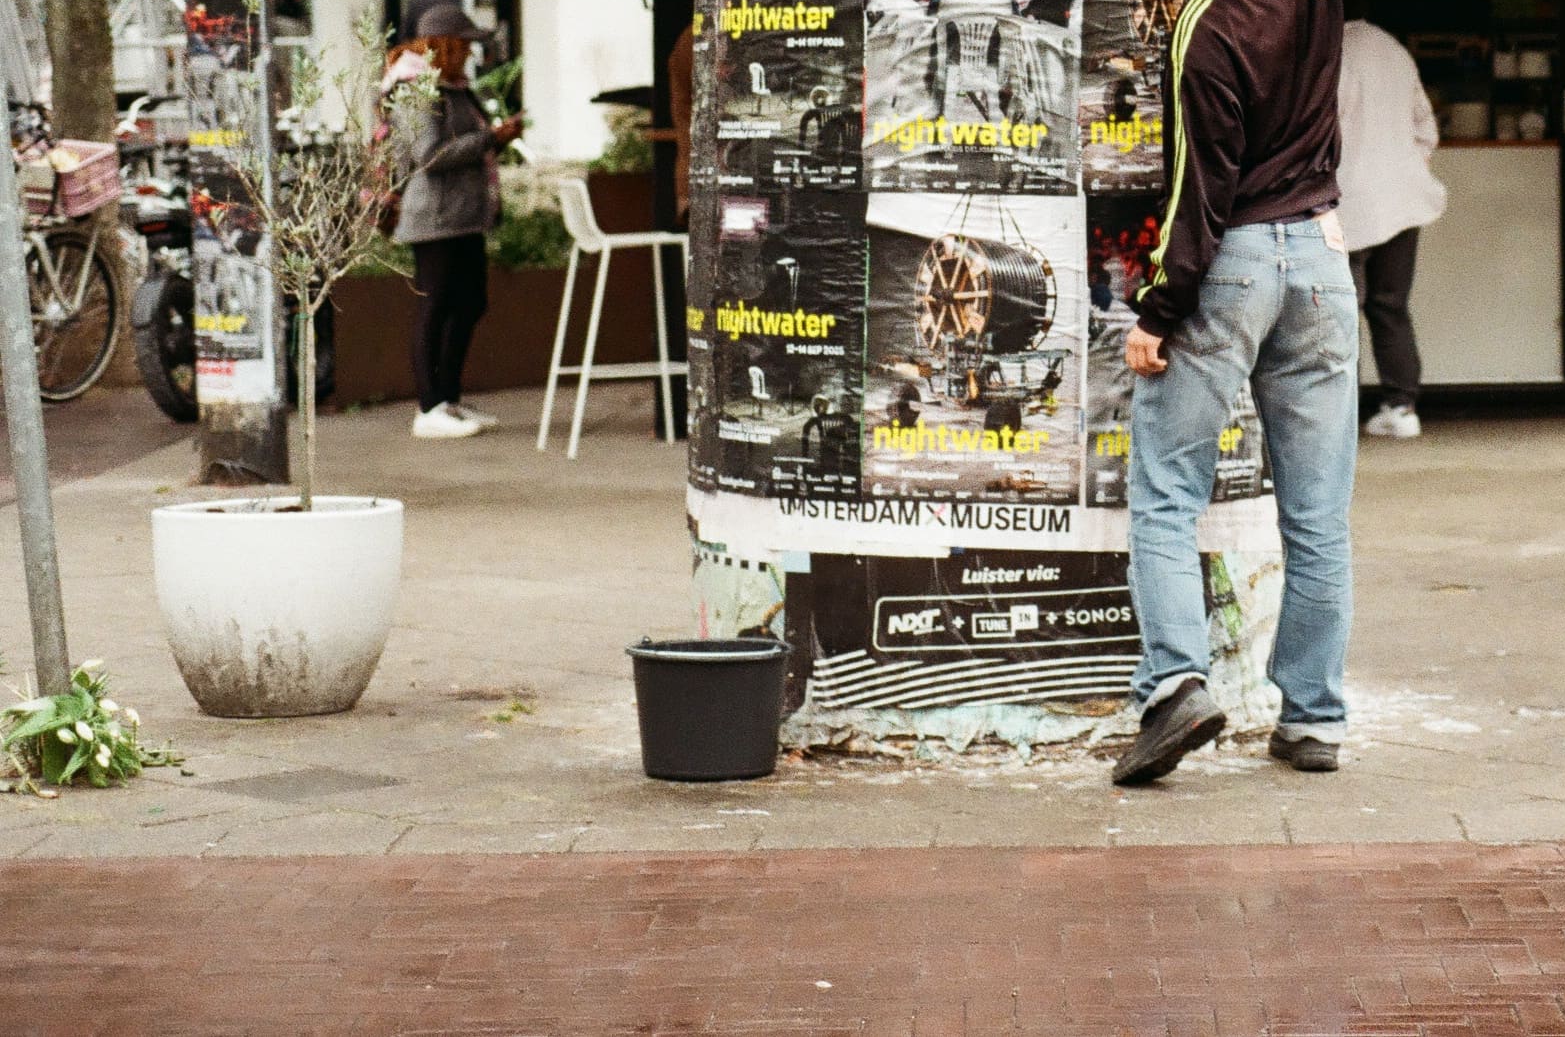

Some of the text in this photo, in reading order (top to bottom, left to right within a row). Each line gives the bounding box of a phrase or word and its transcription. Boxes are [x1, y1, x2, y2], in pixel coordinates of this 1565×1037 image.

[873, 112, 1049, 152] nightwater
[716, 300, 836, 341] nightwater
[873, 419, 1050, 456] nightwater
[950, 502, 1070, 534] MUSEUM
[962, 564, 1061, 584] Luister via:
[978, 618, 1009, 632] TUNE
[1018, 612, 1032, 623] IN
[1065, 607, 1132, 626] SONOS
